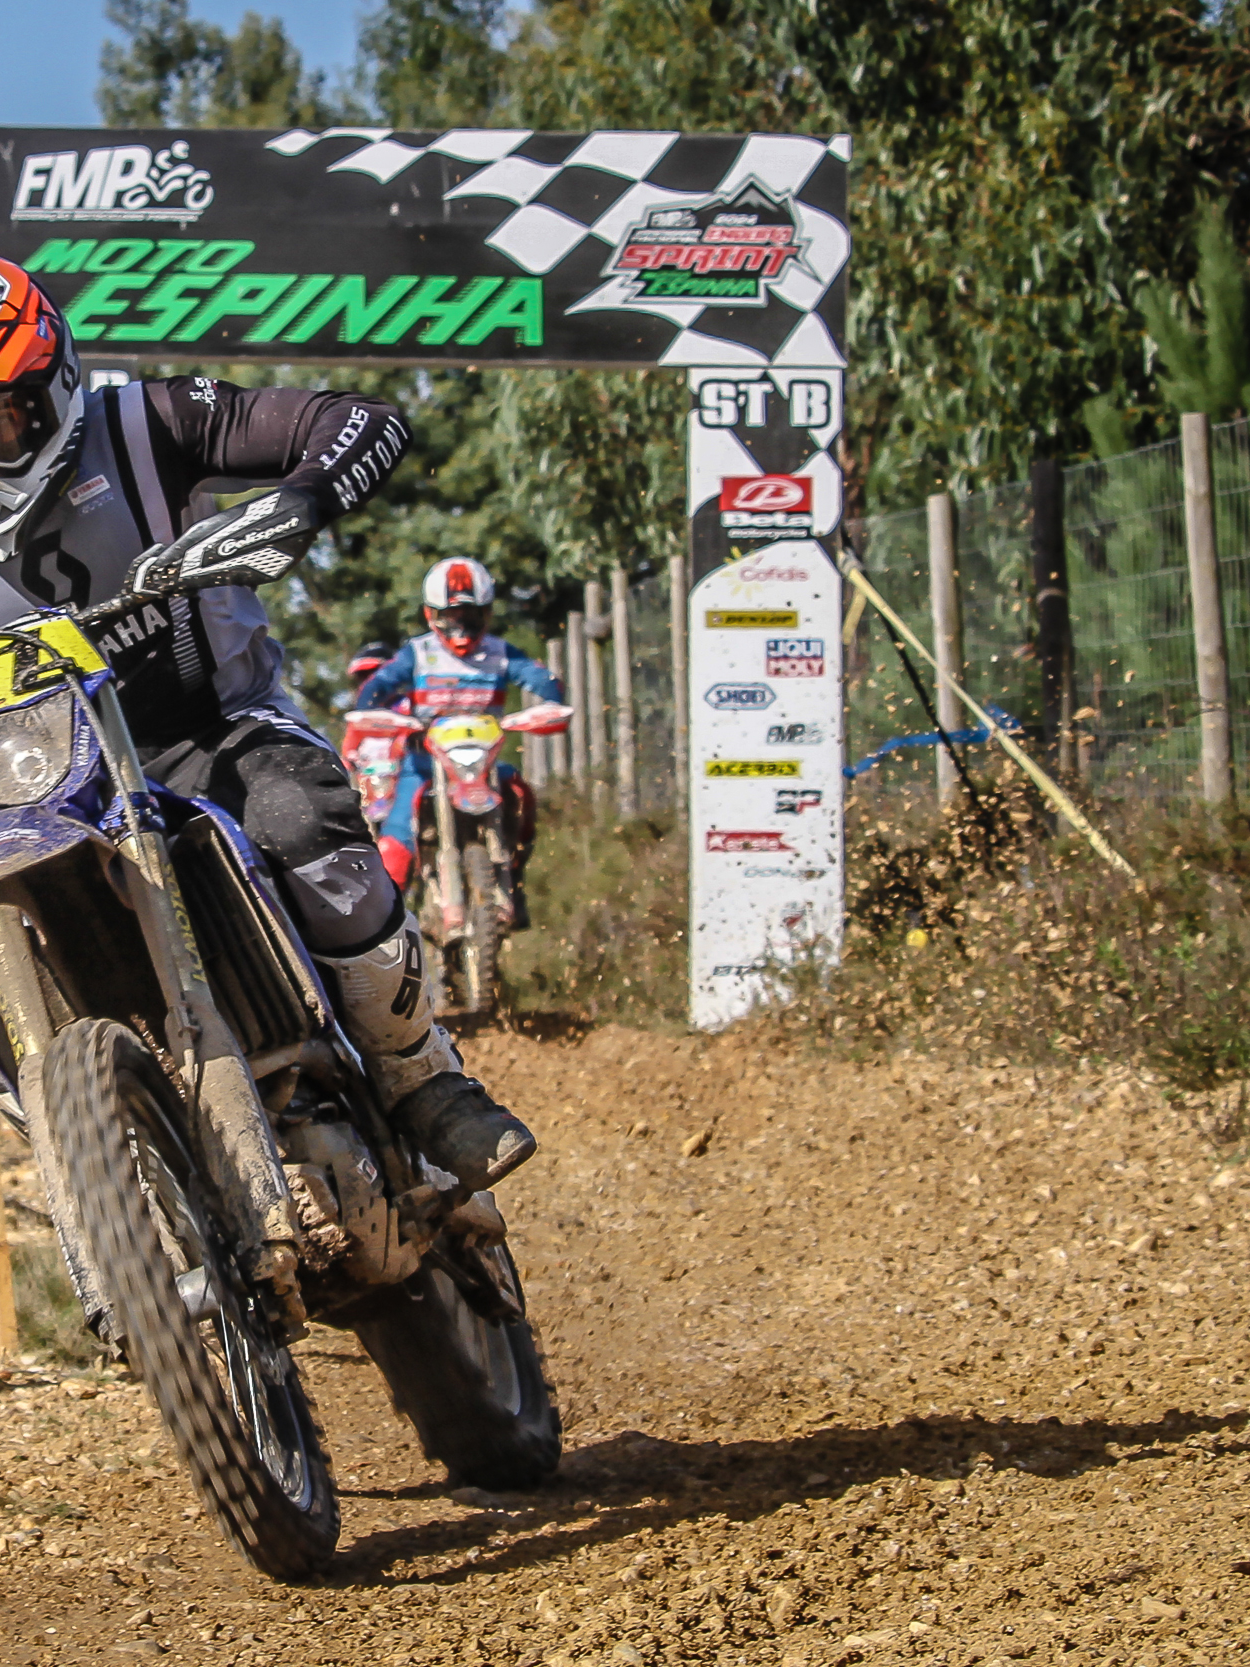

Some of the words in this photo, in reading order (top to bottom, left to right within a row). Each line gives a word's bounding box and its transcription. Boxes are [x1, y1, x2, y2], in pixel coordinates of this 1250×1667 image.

[14, 145, 152, 209] FMP
[21, 238, 256, 273] MOTO
[616, 244, 799, 276] SPRINT
[62, 272, 544, 346] ESPINHA
[790, 380, 830, 427] B
[720, 511, 813, 528] Beta
[97, 603, 169, 654] AHA
[714, 689, 766, 703] SHOEI
[75, 724, 91, 767] YAMAHA
